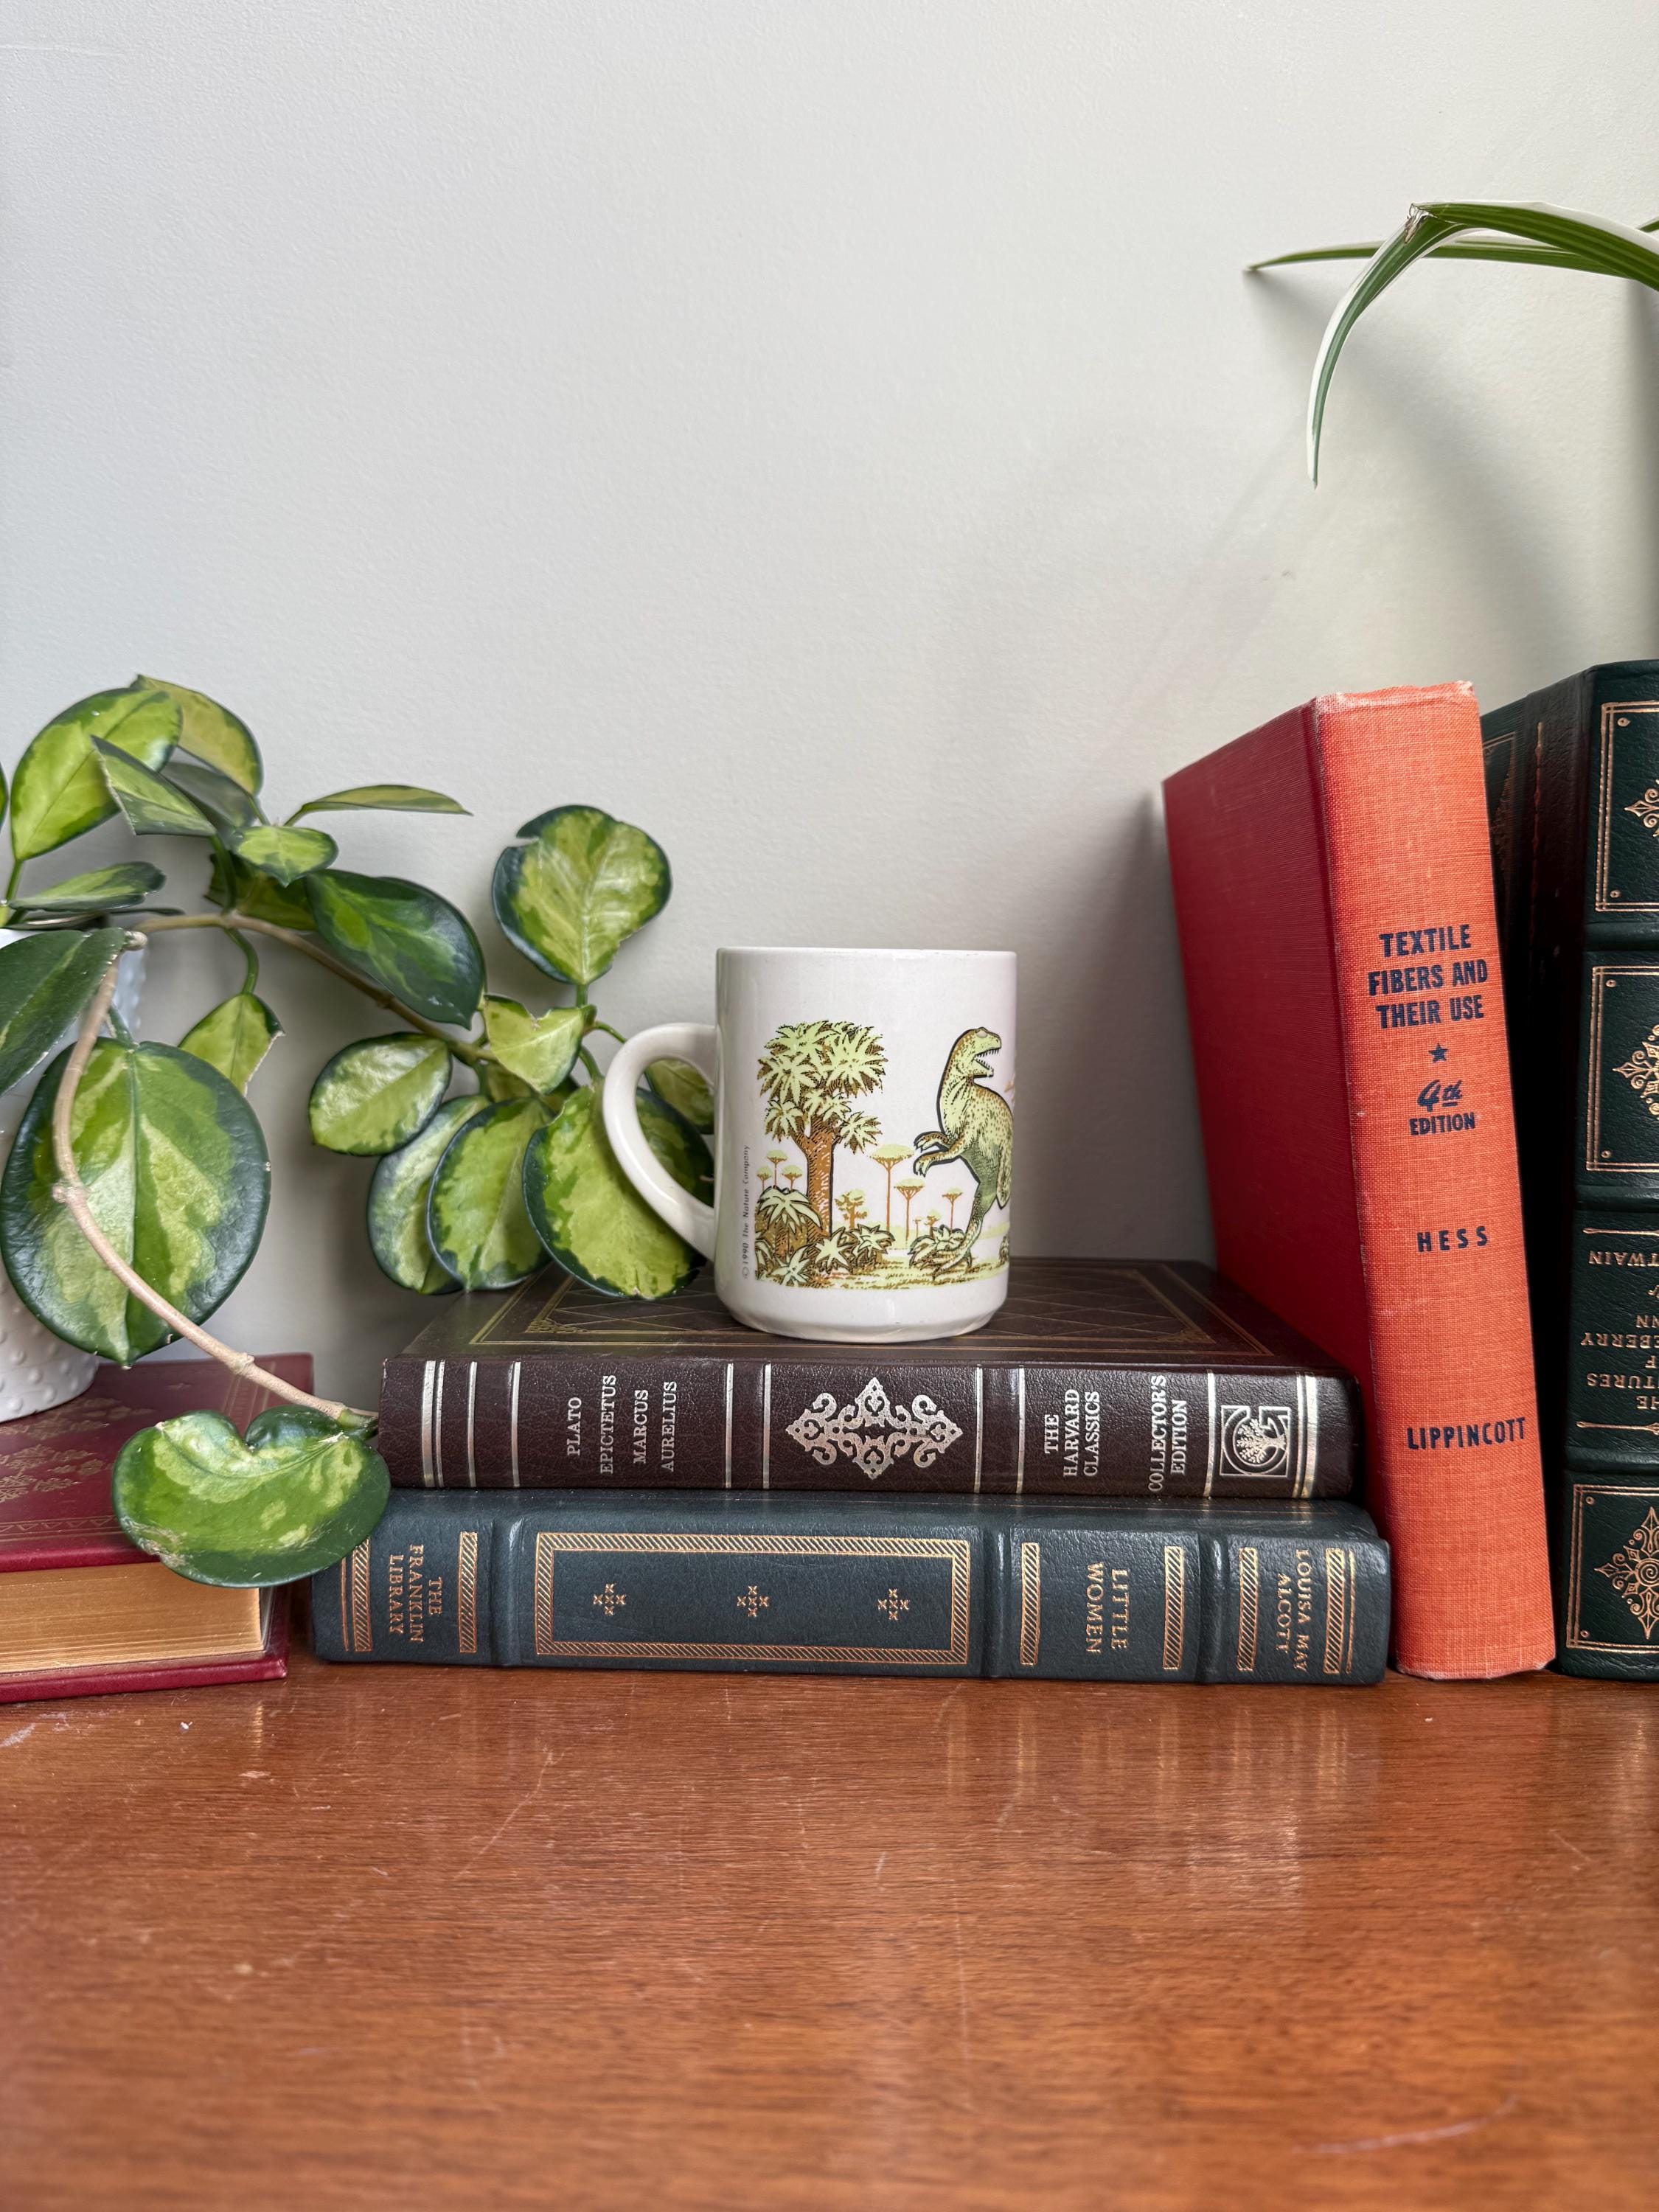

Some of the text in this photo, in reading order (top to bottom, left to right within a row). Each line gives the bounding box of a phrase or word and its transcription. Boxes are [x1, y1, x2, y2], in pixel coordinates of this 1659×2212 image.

[1379, 924, 1472, 958] TEXTILE
[1368, 959, 1488, 996] FIBERS AND
[1375, 994, 1485, 1029] THEIR USE
[1408, 1111, 1476, 1135] EDITION
[1416, 1079, 1463, 1113] 4th
[742, 1145, 751, 1185] Company
[742, 1189, 750, 1218] Nature
[742, 1222, 750, 1238] The
[1416, 1225, 1489, 1253] HESS
[1587, 1250, 1659, 1267] TWAIN
[566, 1397, 582, 1456] PLATO
[599, 1374, 616, 1475] EPICTETUS
[633, 1389, 649, 1464] MARCUS
[661, 1380, 678, 1472] AURELIUS
[1043, 1413, 1060, 1454] THE
[1063, 1388, 1080, 1478] HARVARD
[1083, 1391, 1101, 1477] CLASSICS
[1147, 1374, 1167, 1492] COLLECTOR'S
[1170, 1399, 1188, 1475] EDITION
[1406, 1416, 1526, 1450] LIPPINCOTT
[389, 1554, 405, 1635] LIBRARY
[408, 1543, 425, 1644] FRANKLIN
[428, 1576, 443, 1616] THE
[1085, 1560, 1105, 1655] WOMEN
[1110, 1568, 1130, 1650] LITTLE
[1276, 1572, 1293, 1655] ALCOTT
[1293, 1548, 1313, 1674] LOUISA MAY
